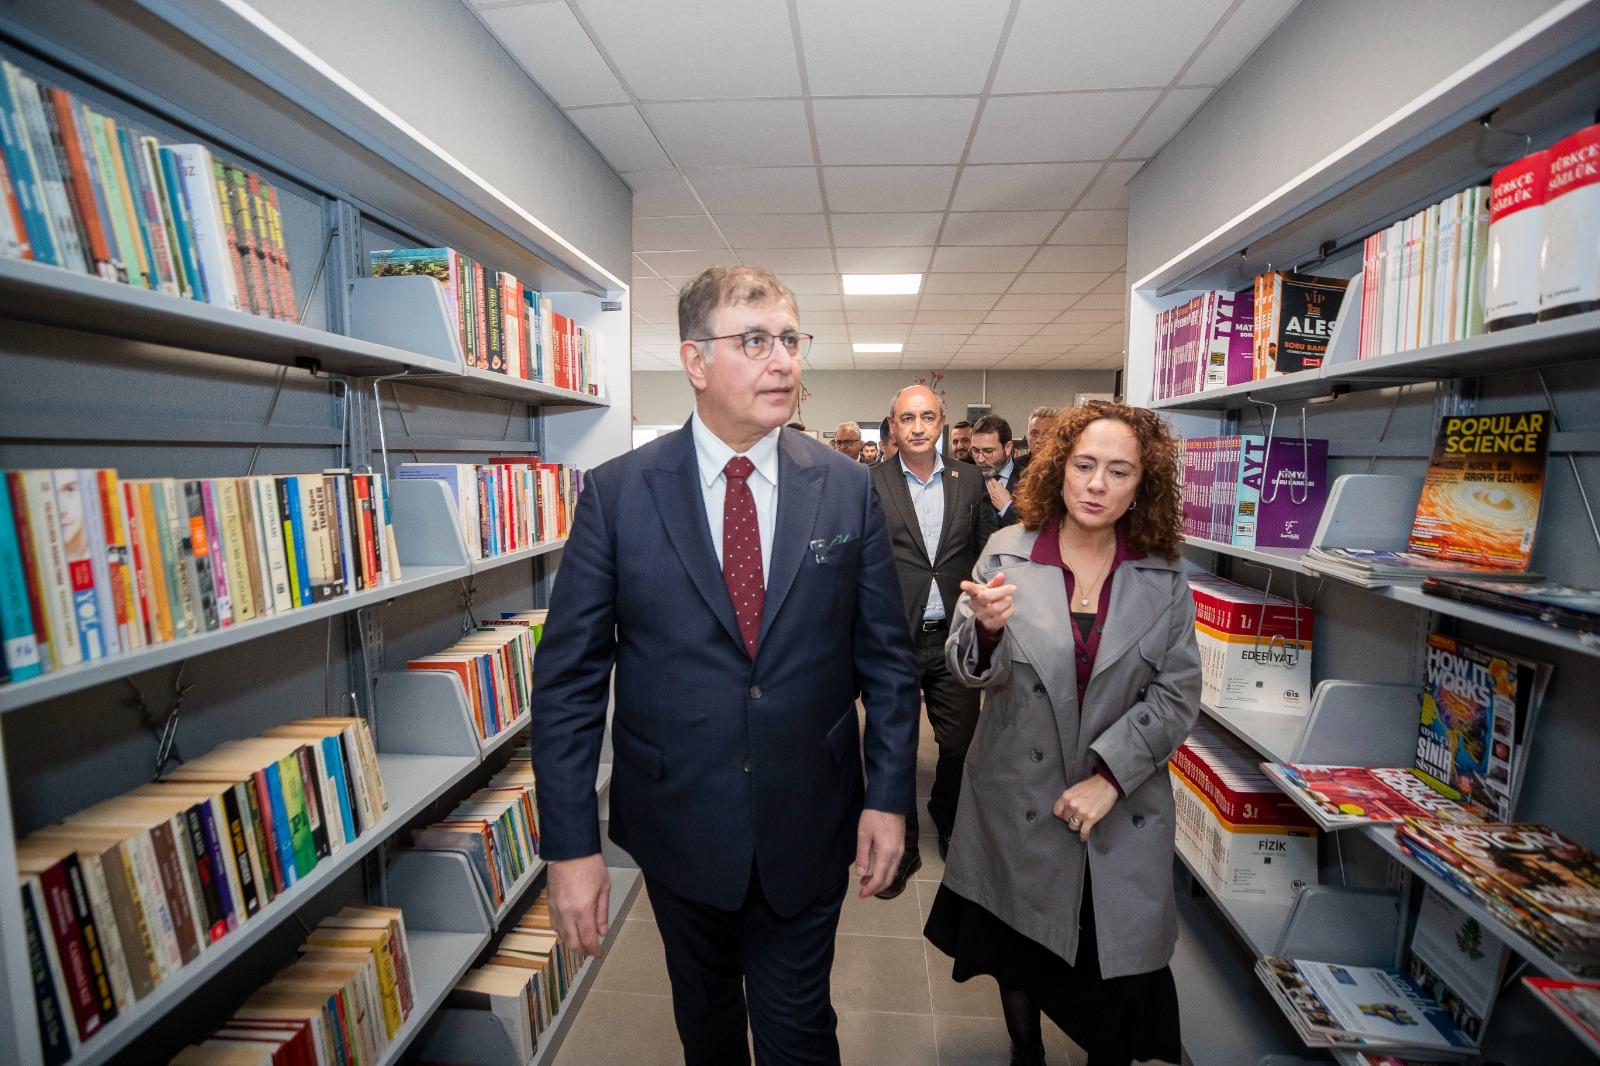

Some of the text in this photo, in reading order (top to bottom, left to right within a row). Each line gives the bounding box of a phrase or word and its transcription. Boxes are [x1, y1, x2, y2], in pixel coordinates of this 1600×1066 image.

[1550, 143, 1600, 174] TÜRKÇE
[1493, 173, 1535, 198] TÜRKÇE
[1548, 162, 1597, 191] SÖZLÜK
[1492, 188, 1533, 212] SÖZLÜK
[1214, 292, 1235, 340] TYT
[1286, 316, 1339, 334] ALES
[1446, 414, 1544, 435] POPULAR
[1445, 434, 1538, 453] SCIENCE
[1242, 439, 1265, 491] AYT
[1241, 650, 1294, 664] EDEBİYAT
[1428, 646, 1489, 688] HOW IT
[1428, 666, 1491, 707] WORKS
[1416, 736, 1453, 773] SİNİR
[1258, 838, 1287, 852] FİZİK
